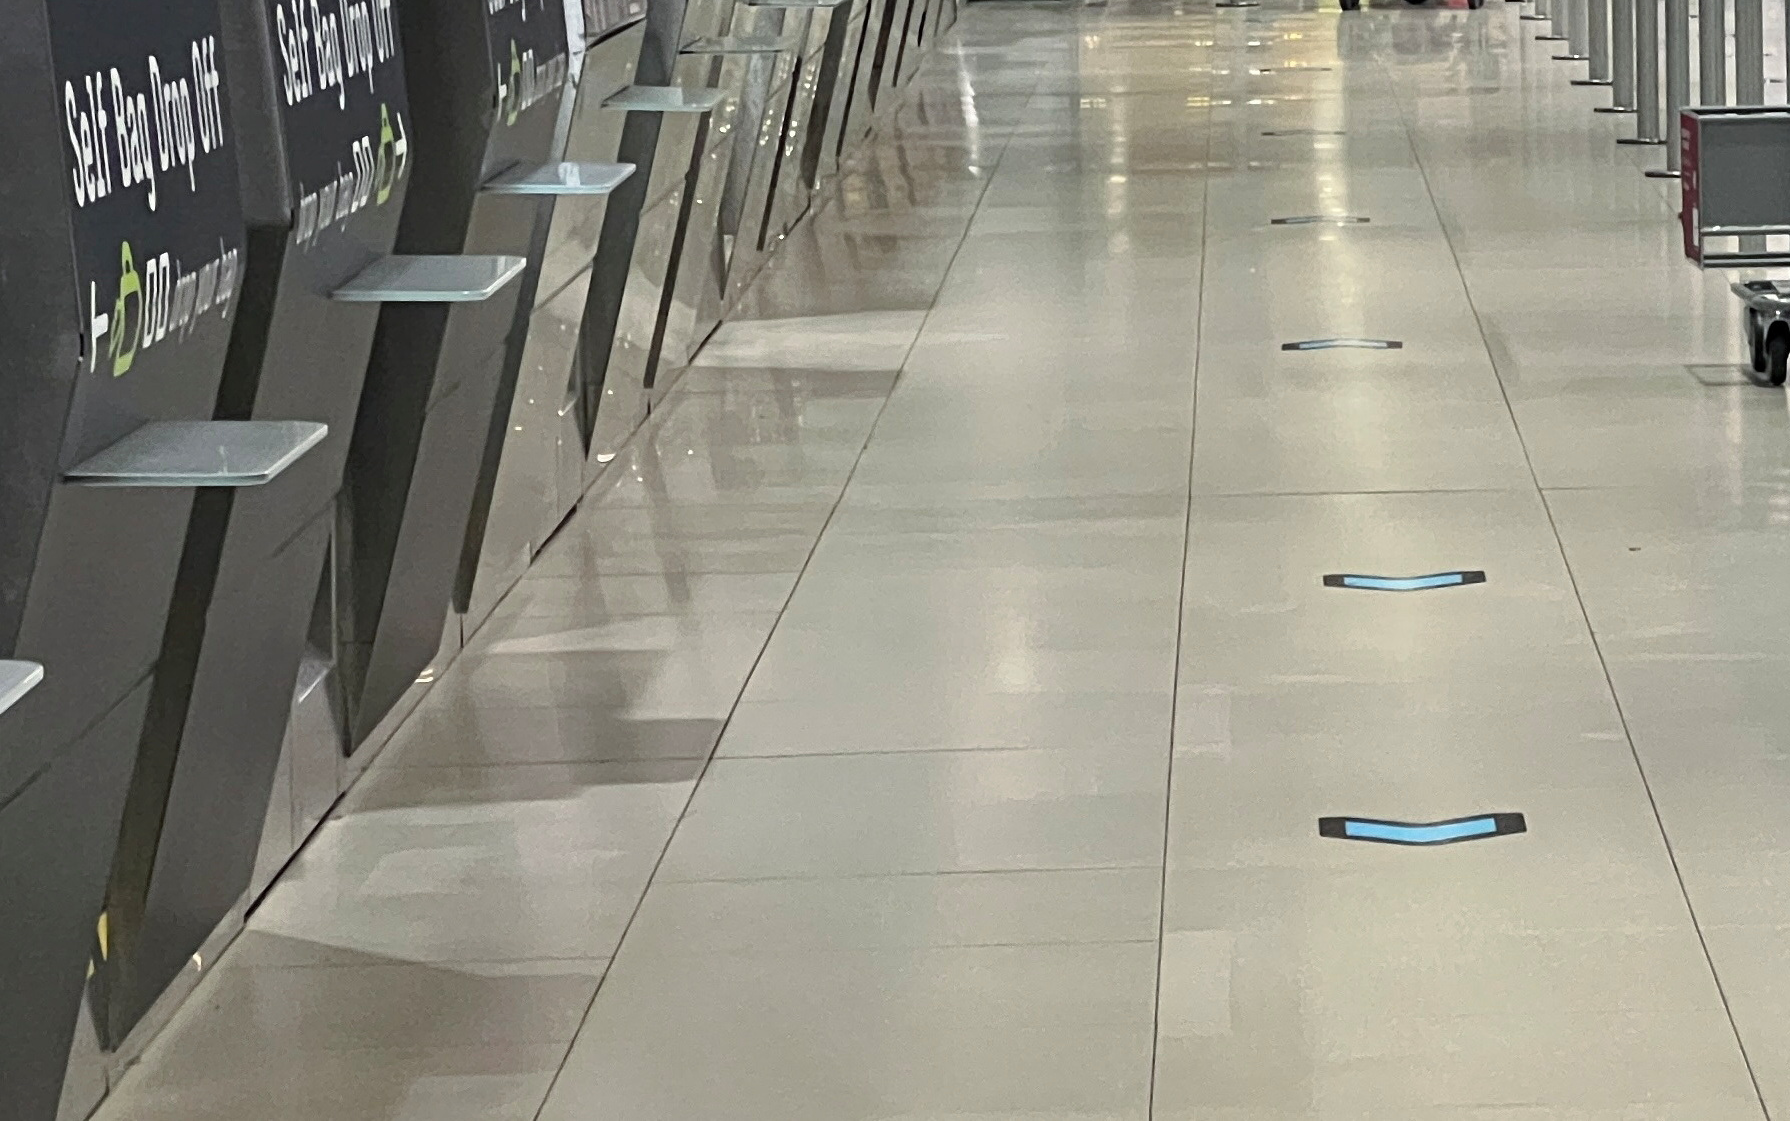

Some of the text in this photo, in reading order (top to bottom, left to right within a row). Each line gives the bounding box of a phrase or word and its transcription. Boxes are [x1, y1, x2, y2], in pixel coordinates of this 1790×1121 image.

[65, 34, 224, 212] Self Bag Drop Off
